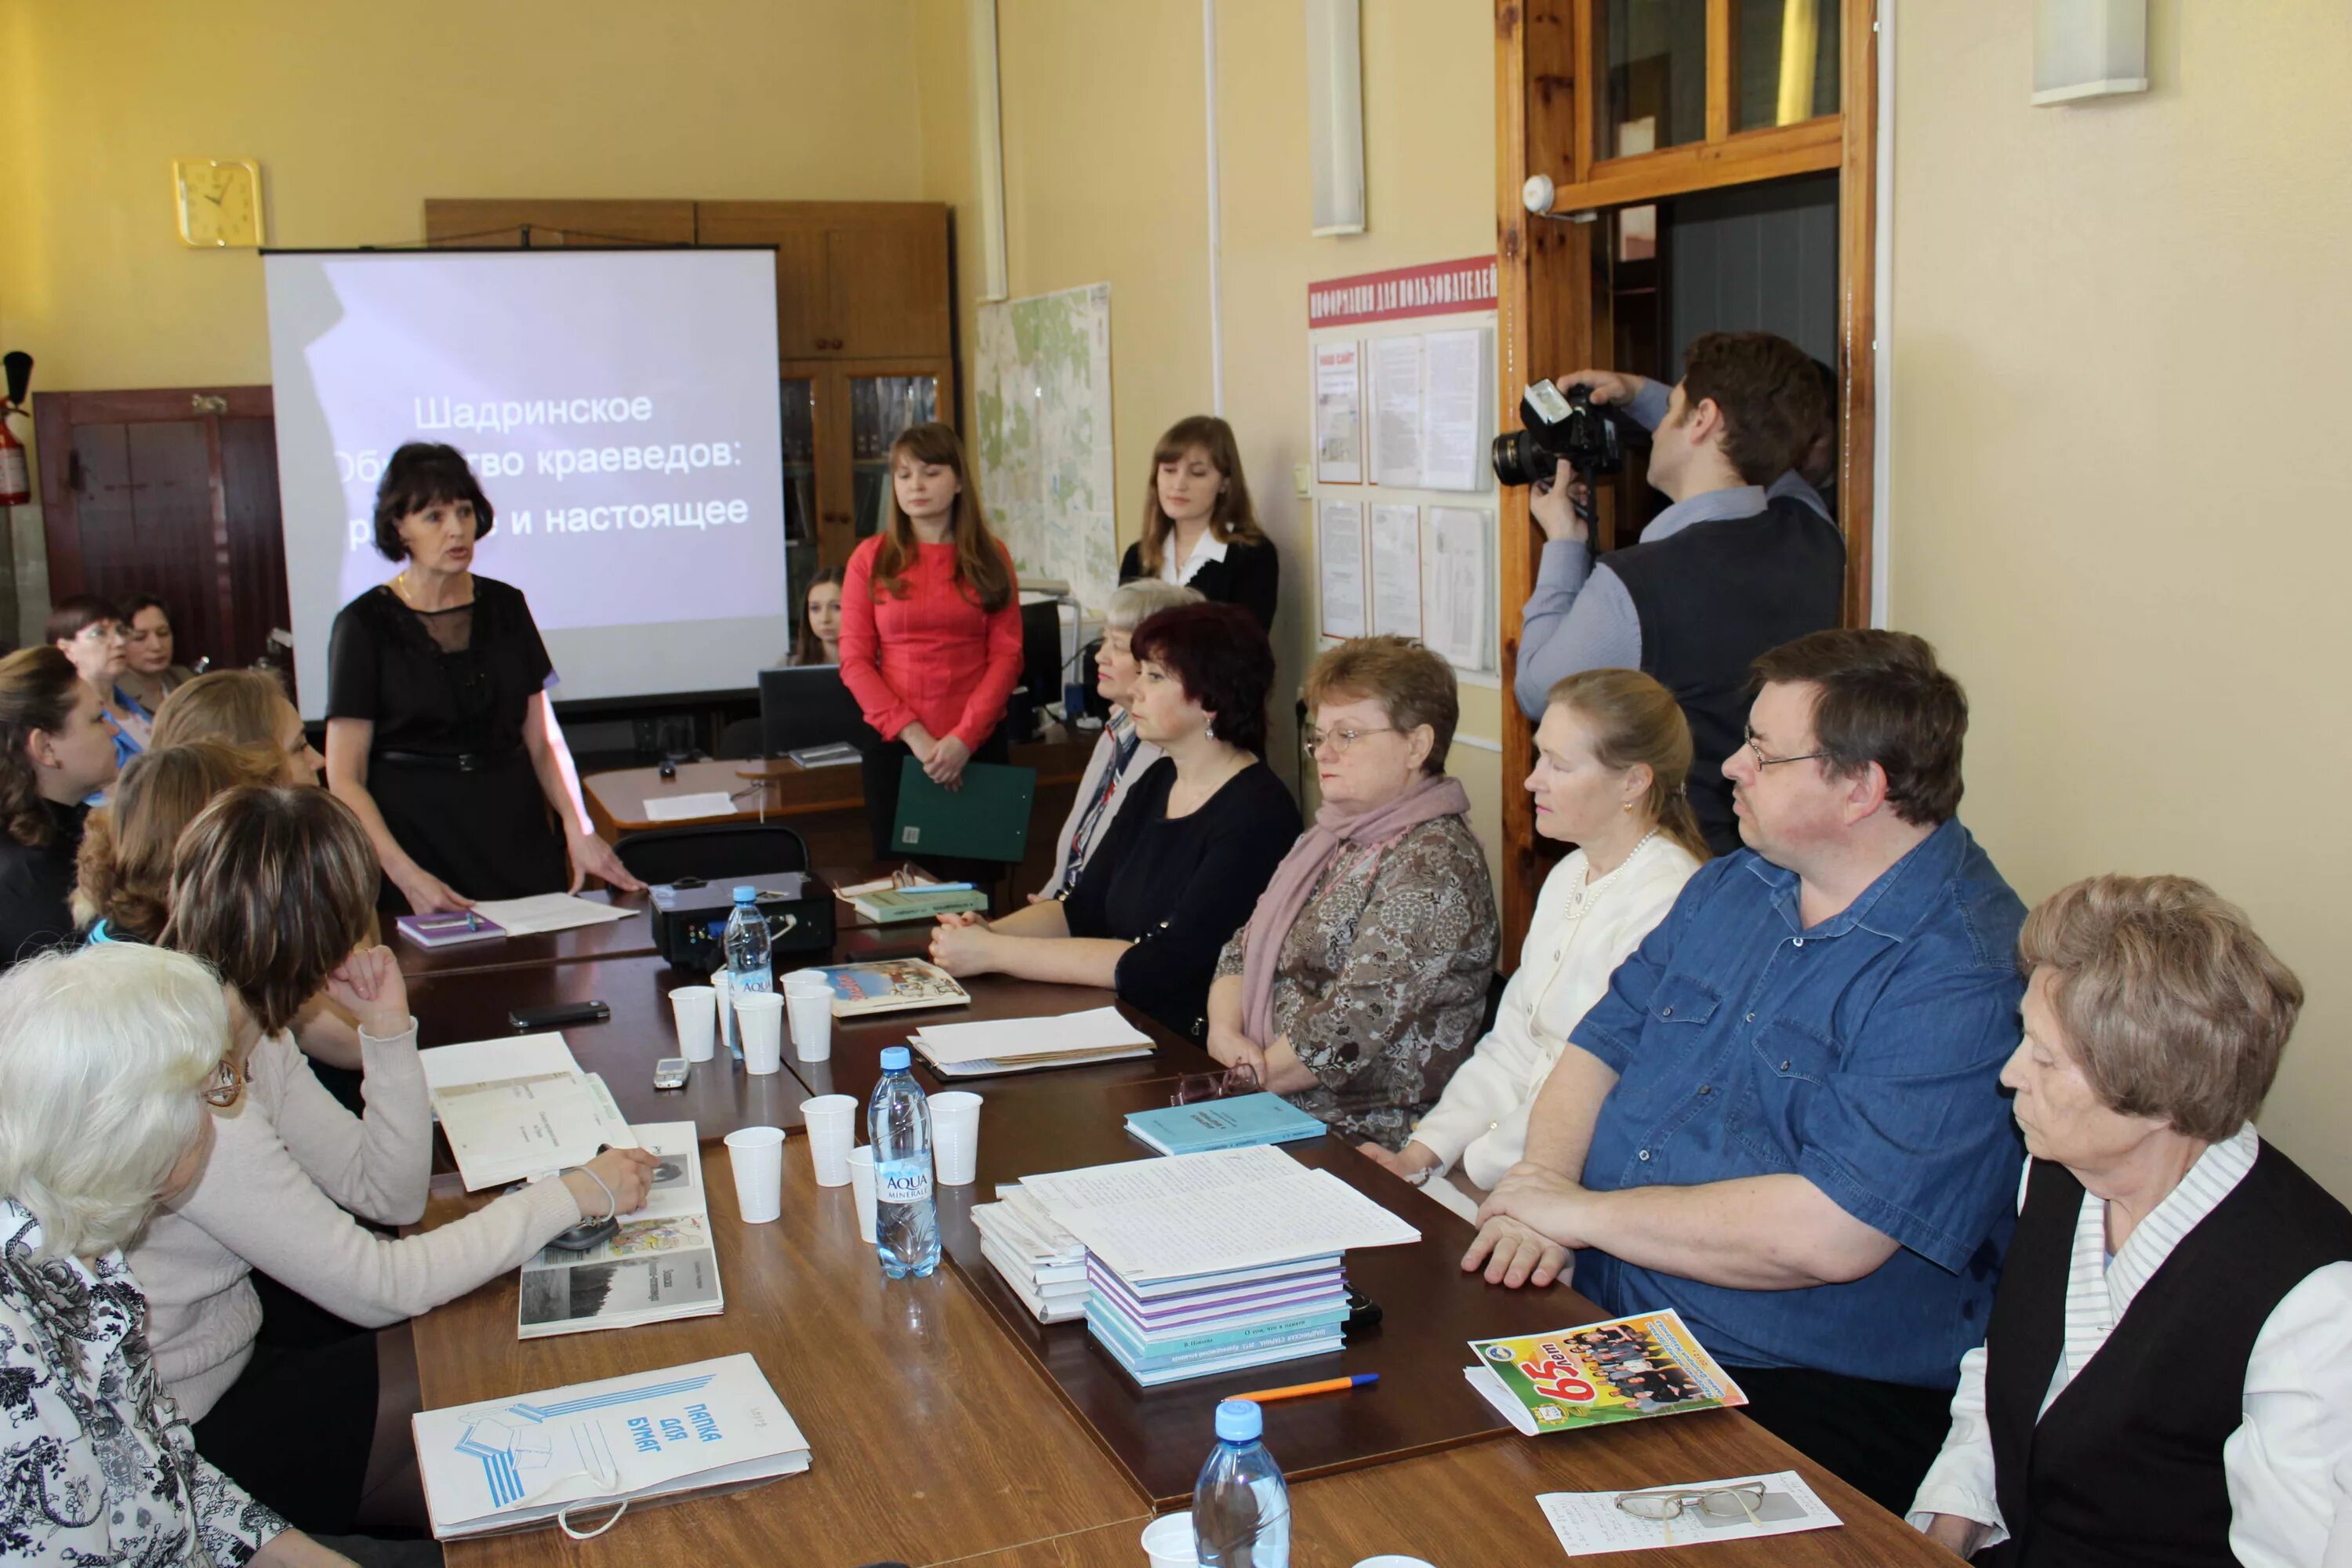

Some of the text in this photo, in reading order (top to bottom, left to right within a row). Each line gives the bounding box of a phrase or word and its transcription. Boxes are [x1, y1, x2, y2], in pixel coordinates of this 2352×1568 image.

[1377, 280, 1397, 313] ДЛЯ
[1399, 263, 1497, 308] ПОЛЬЗОВАТЕЛЕЙ
[414, 393, 652, 434] Шадринское
[537, 439, 742, 480] краеведов:
[511, 510, 532, 535] и
[546, 496, 749, 534] настоящее
[887, 1174, 927, 1191] AQUA
[1542, 1344, 1572, 1366] лет
[1522, 1361, 1595, 1401] 65
[627, 1417, 661, 1452] БУМАГ
[659, 1418, 688, 1441] ДЛЯ
[683, 1403, 722, 1443] ПАПКА
